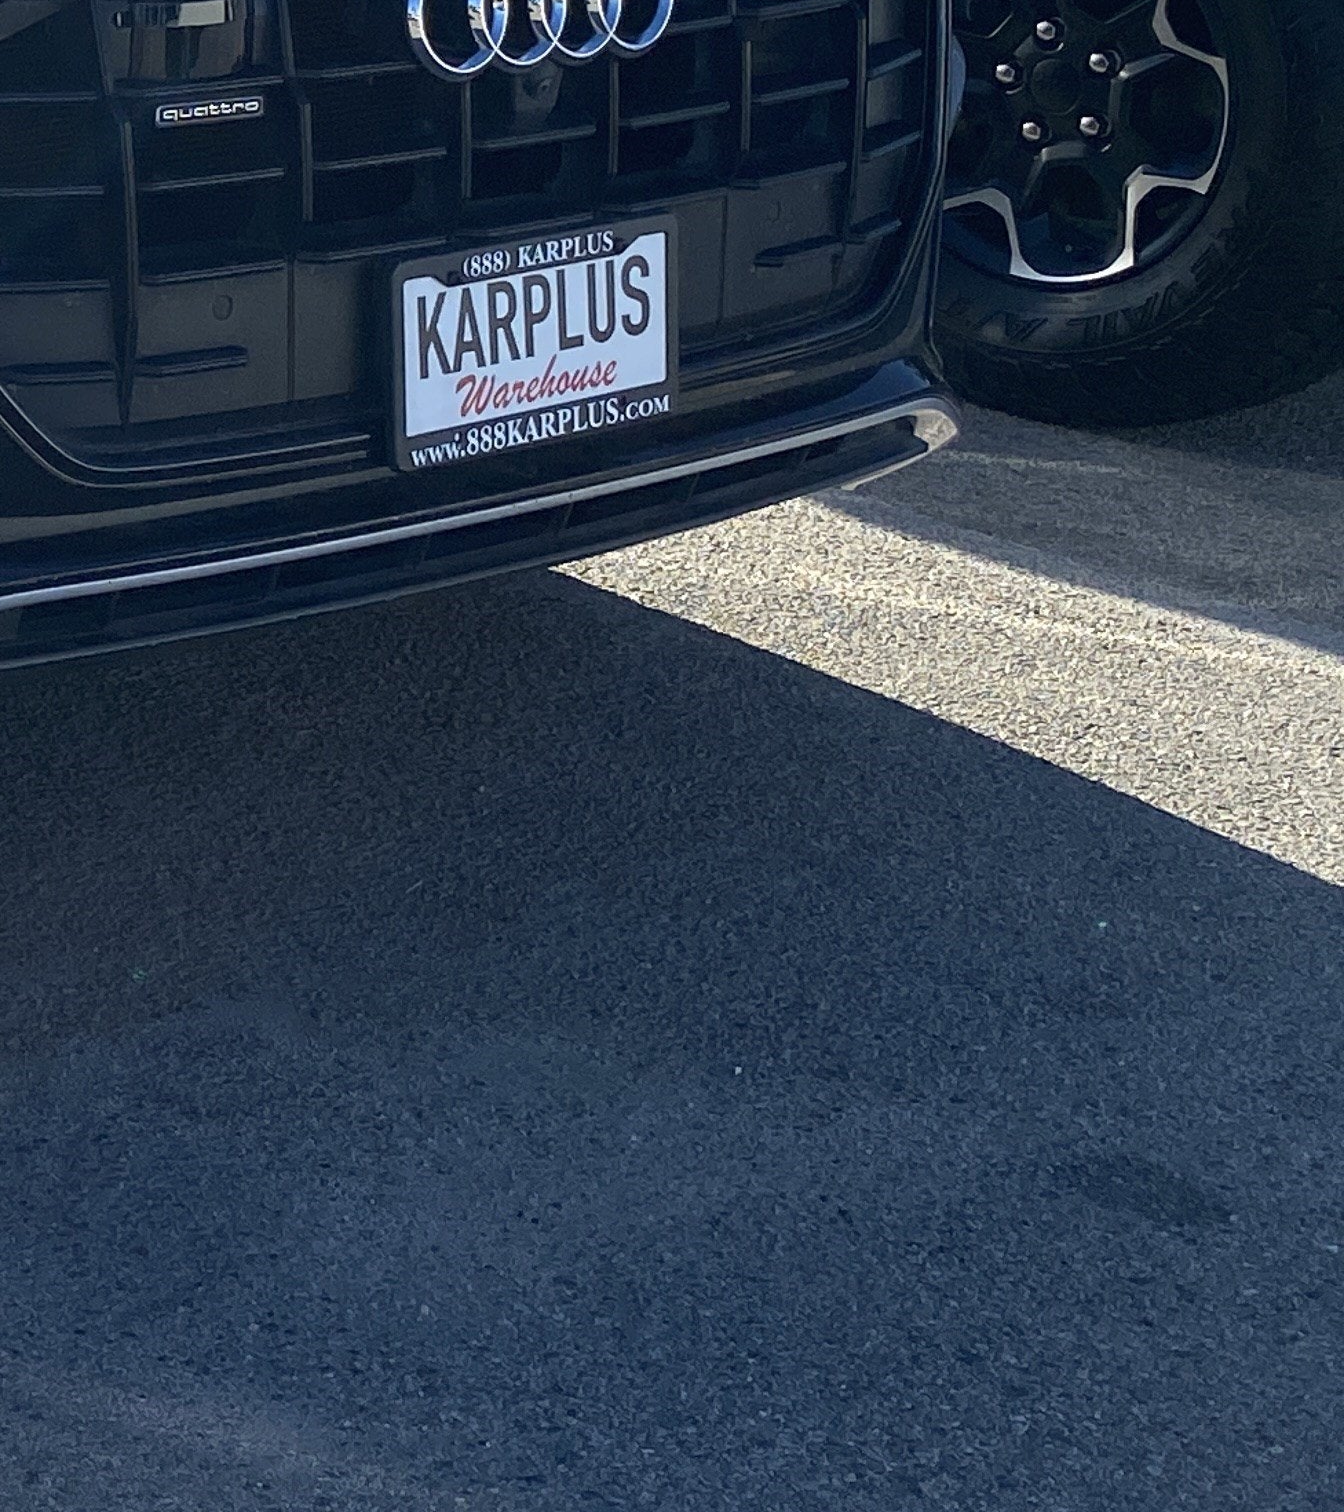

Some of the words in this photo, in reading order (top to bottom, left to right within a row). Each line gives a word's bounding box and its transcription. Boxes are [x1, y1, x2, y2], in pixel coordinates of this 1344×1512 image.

[163, 100, 259, 120] quattro
[463, 250, 511, 278] (888)
[518, 230, 614, 268] KARPLUS
[417, 255, 651, 379] KARPLUS
[455, 354, 618, 417] Warehouse
